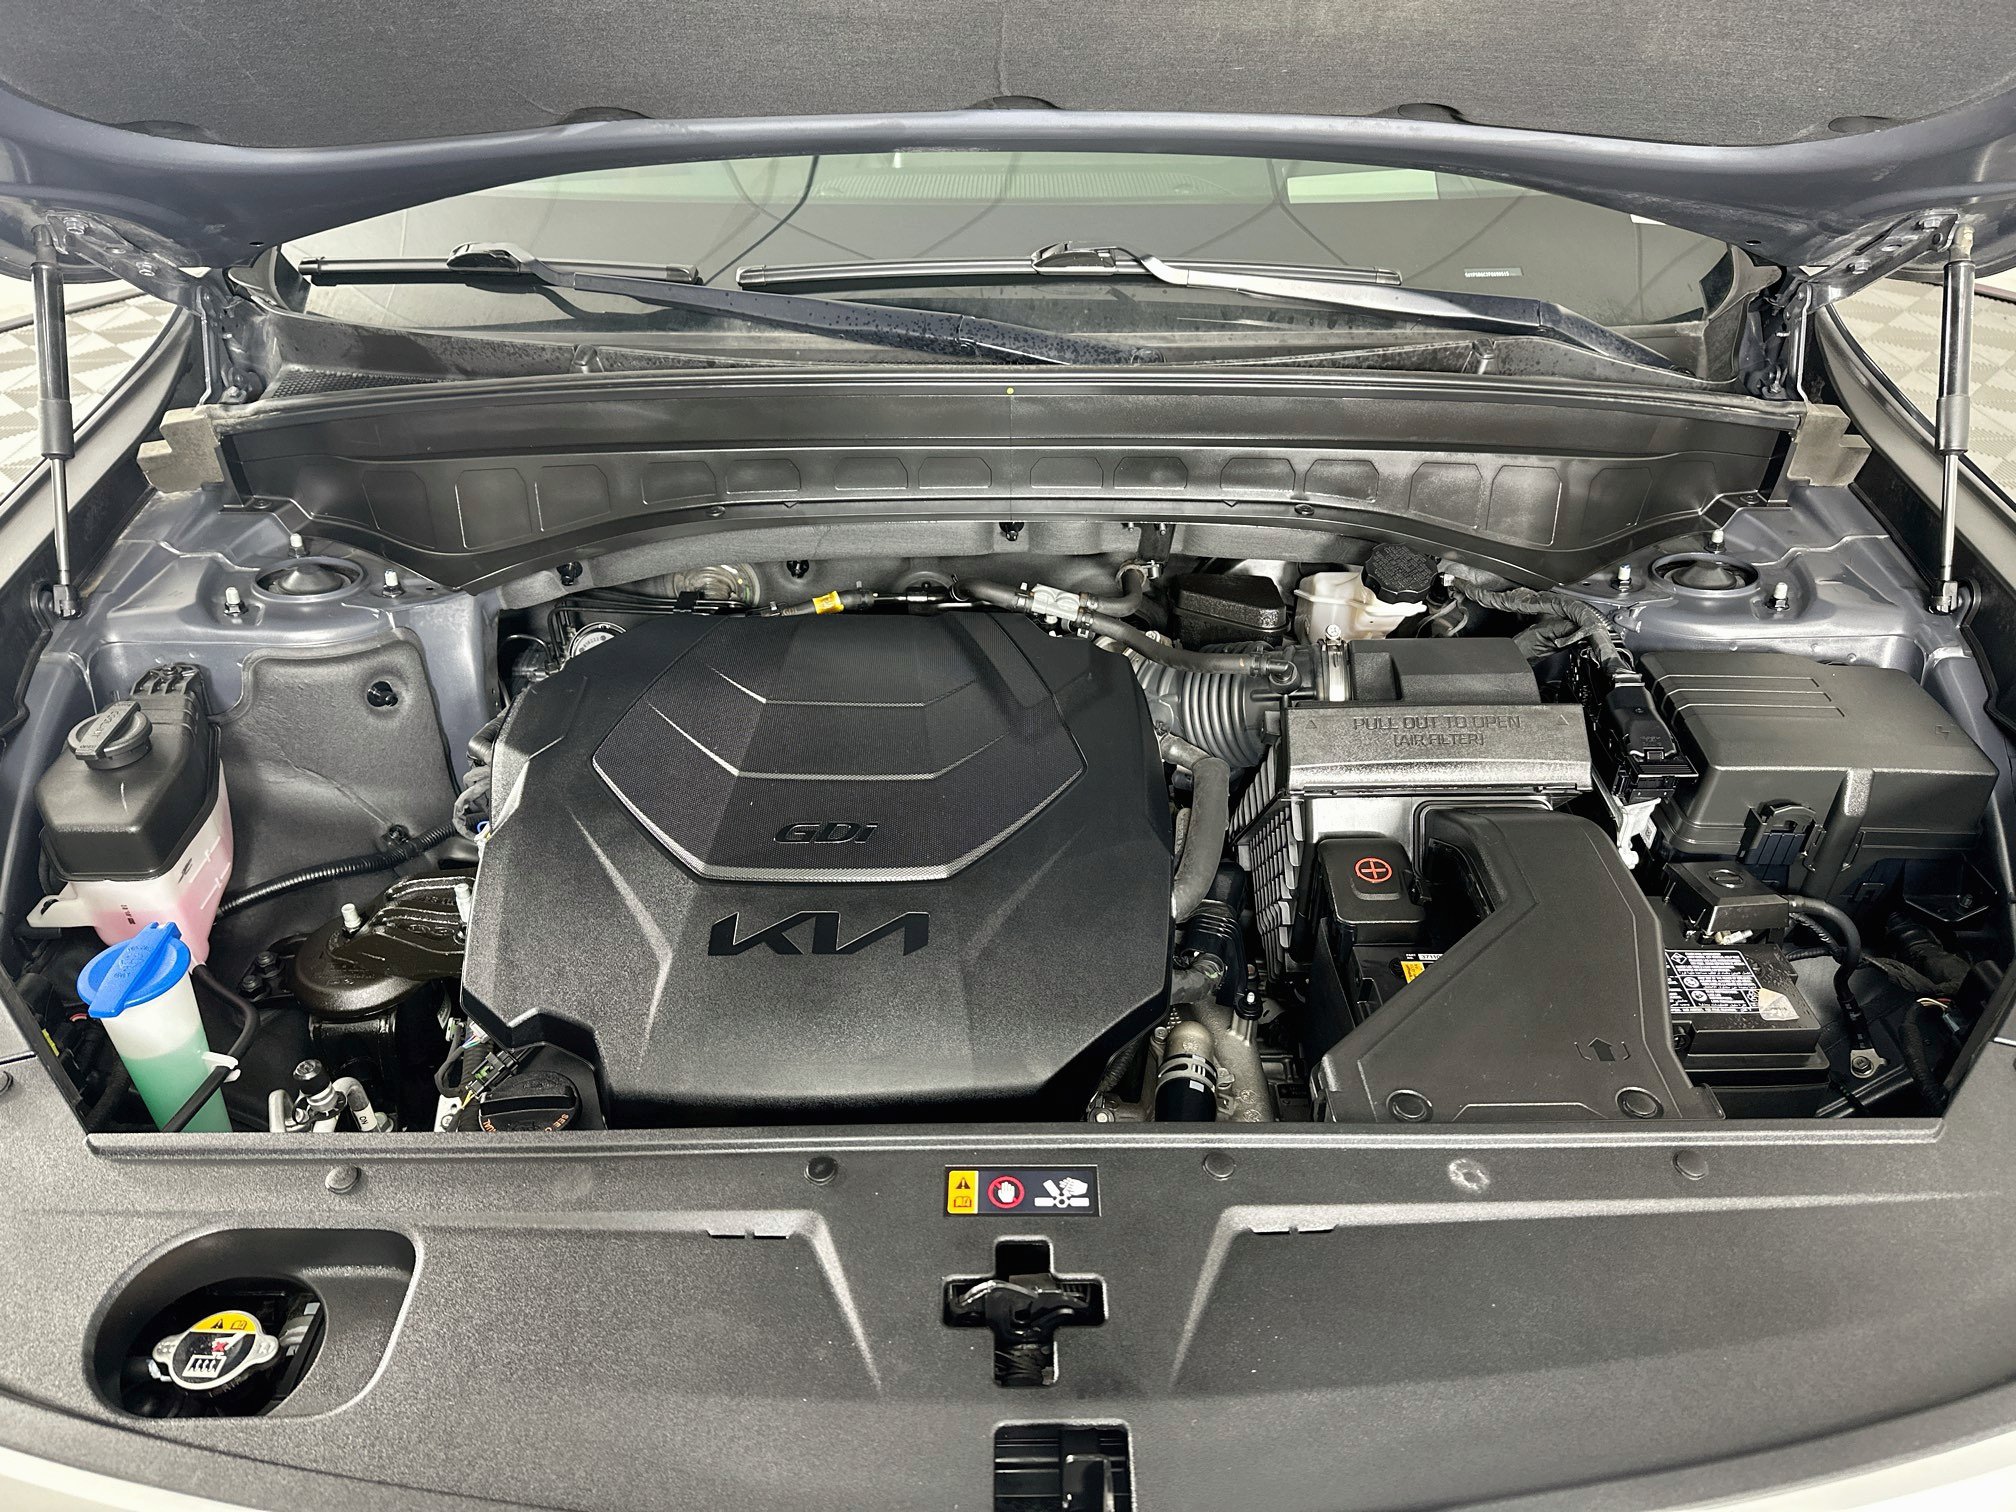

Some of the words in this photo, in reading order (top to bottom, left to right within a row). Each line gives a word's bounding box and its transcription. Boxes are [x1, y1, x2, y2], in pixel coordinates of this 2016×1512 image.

[1353, 716, 1398, 730] PULL
[1402, 715, 1439, 730] OUT
[1443, 715, 1467, 729] TO
[1472, 714, 1521, 729] OPEN
[708, 910, 930, 956] KIA
[552, 1113, 569, 1128] SEE
